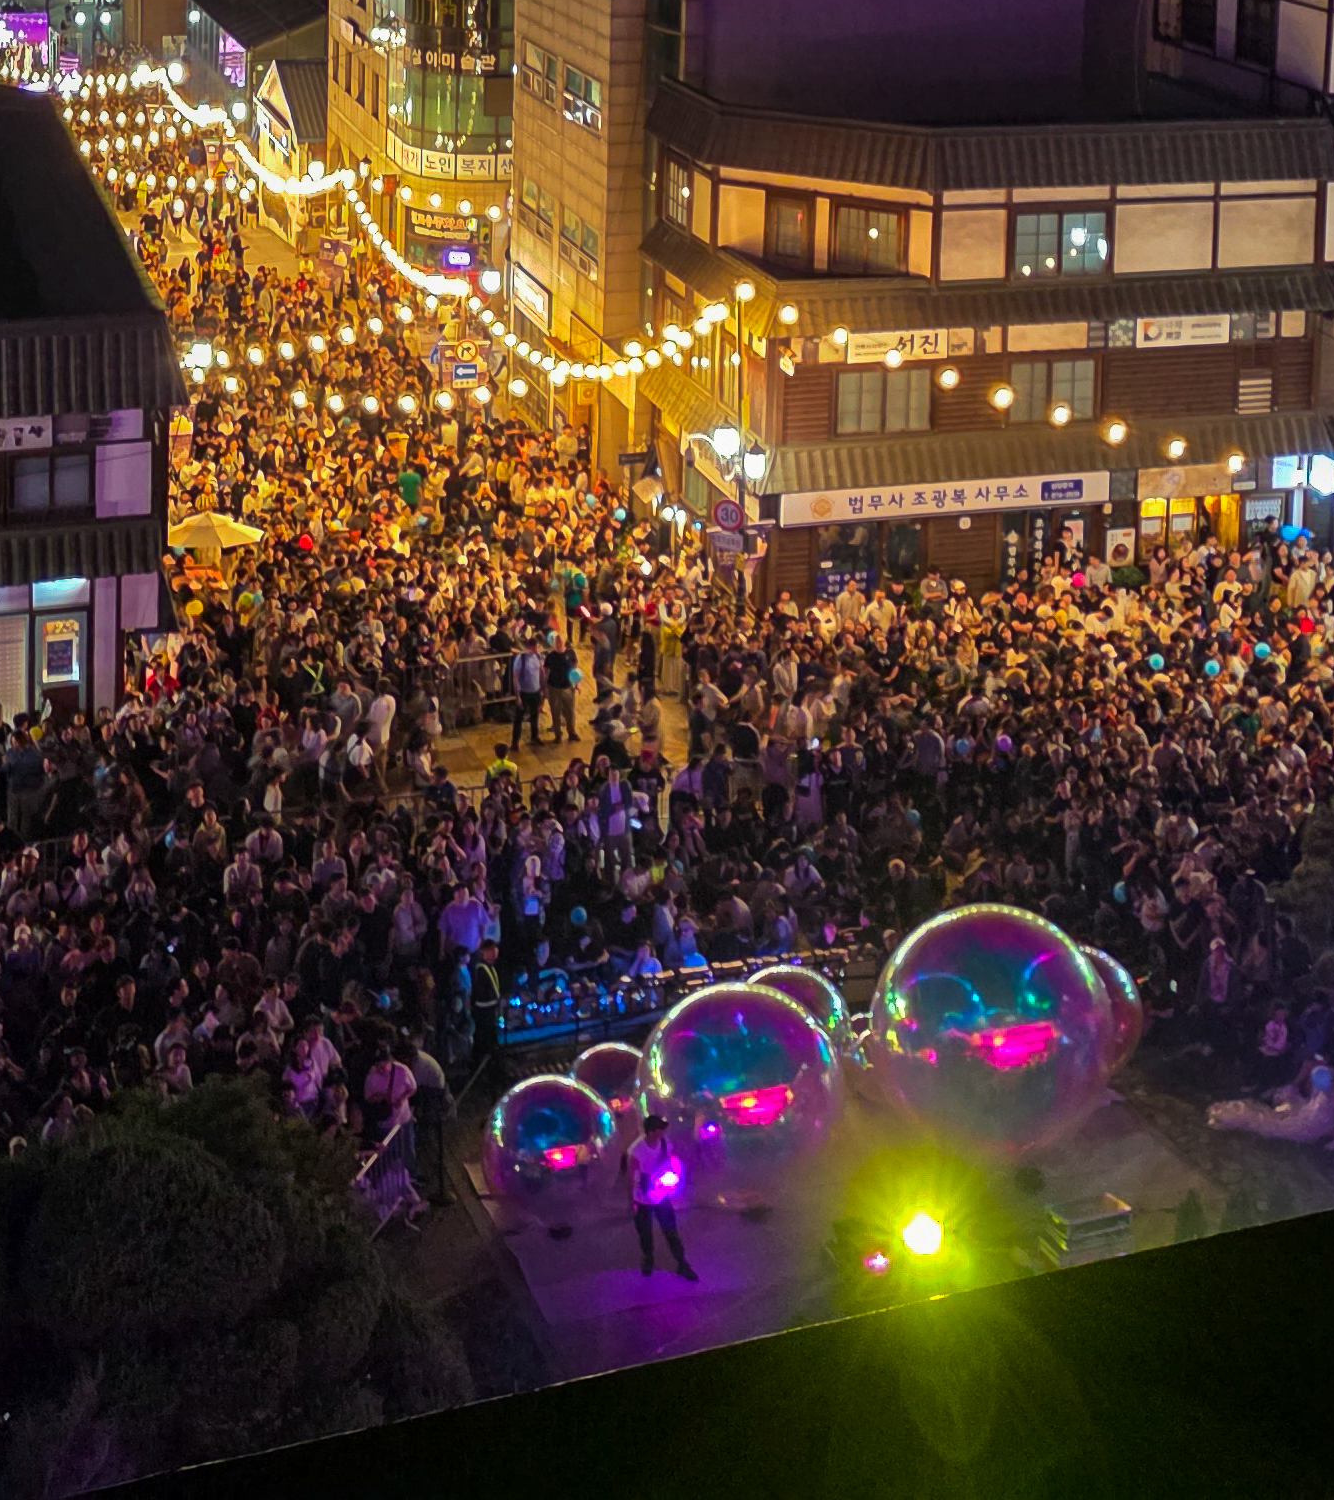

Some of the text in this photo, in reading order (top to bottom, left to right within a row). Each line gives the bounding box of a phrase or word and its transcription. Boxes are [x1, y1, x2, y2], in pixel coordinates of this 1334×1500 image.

[896, 332, 940, 355] 서진
[848, 494, 905, 514] 법무사
[912, 489, 967, 509] 조광복
[975, 484, 1030, 503] 사무소
[720, 506, 739, 523] 30
